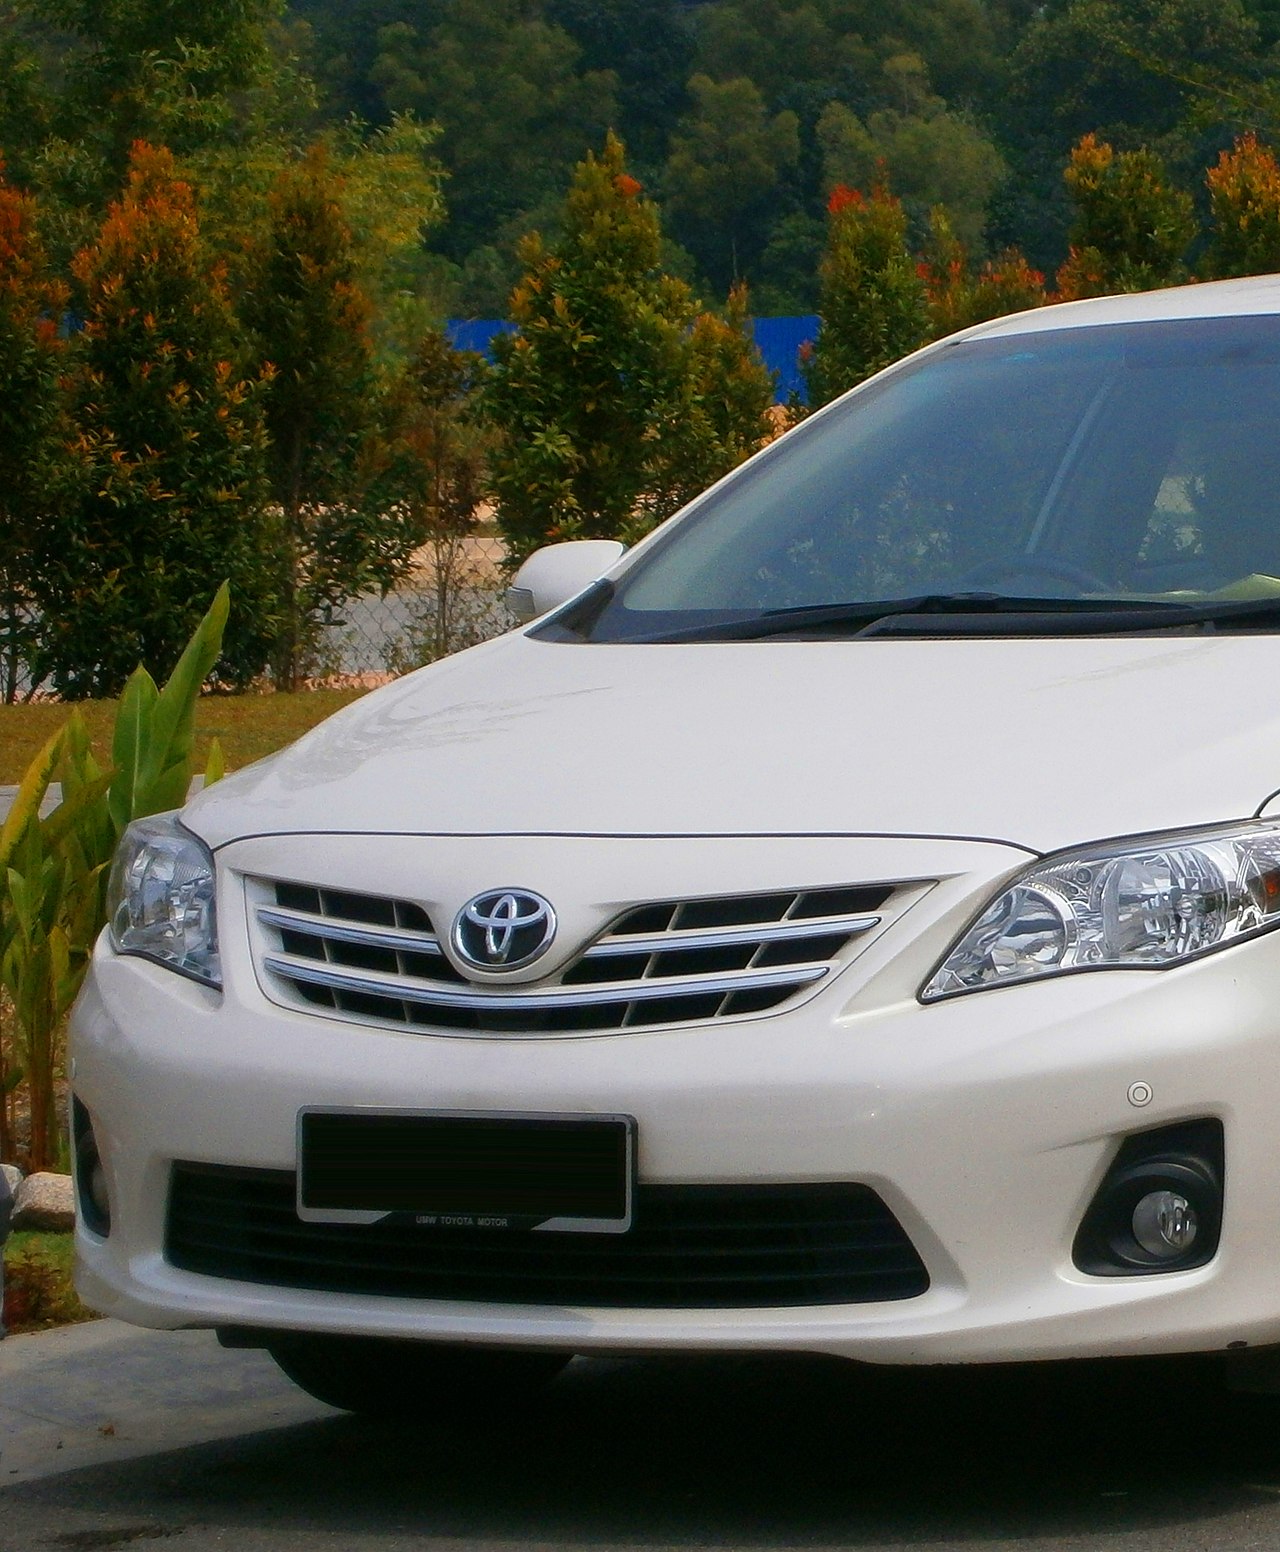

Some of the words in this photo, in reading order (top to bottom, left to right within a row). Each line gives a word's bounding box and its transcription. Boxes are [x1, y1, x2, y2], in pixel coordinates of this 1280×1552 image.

[415, 1215, 438, 1225] UMW
[440, 1216, 474, 1226] TOYOTA
[477, 1217, 508, 1227] MOTOR
